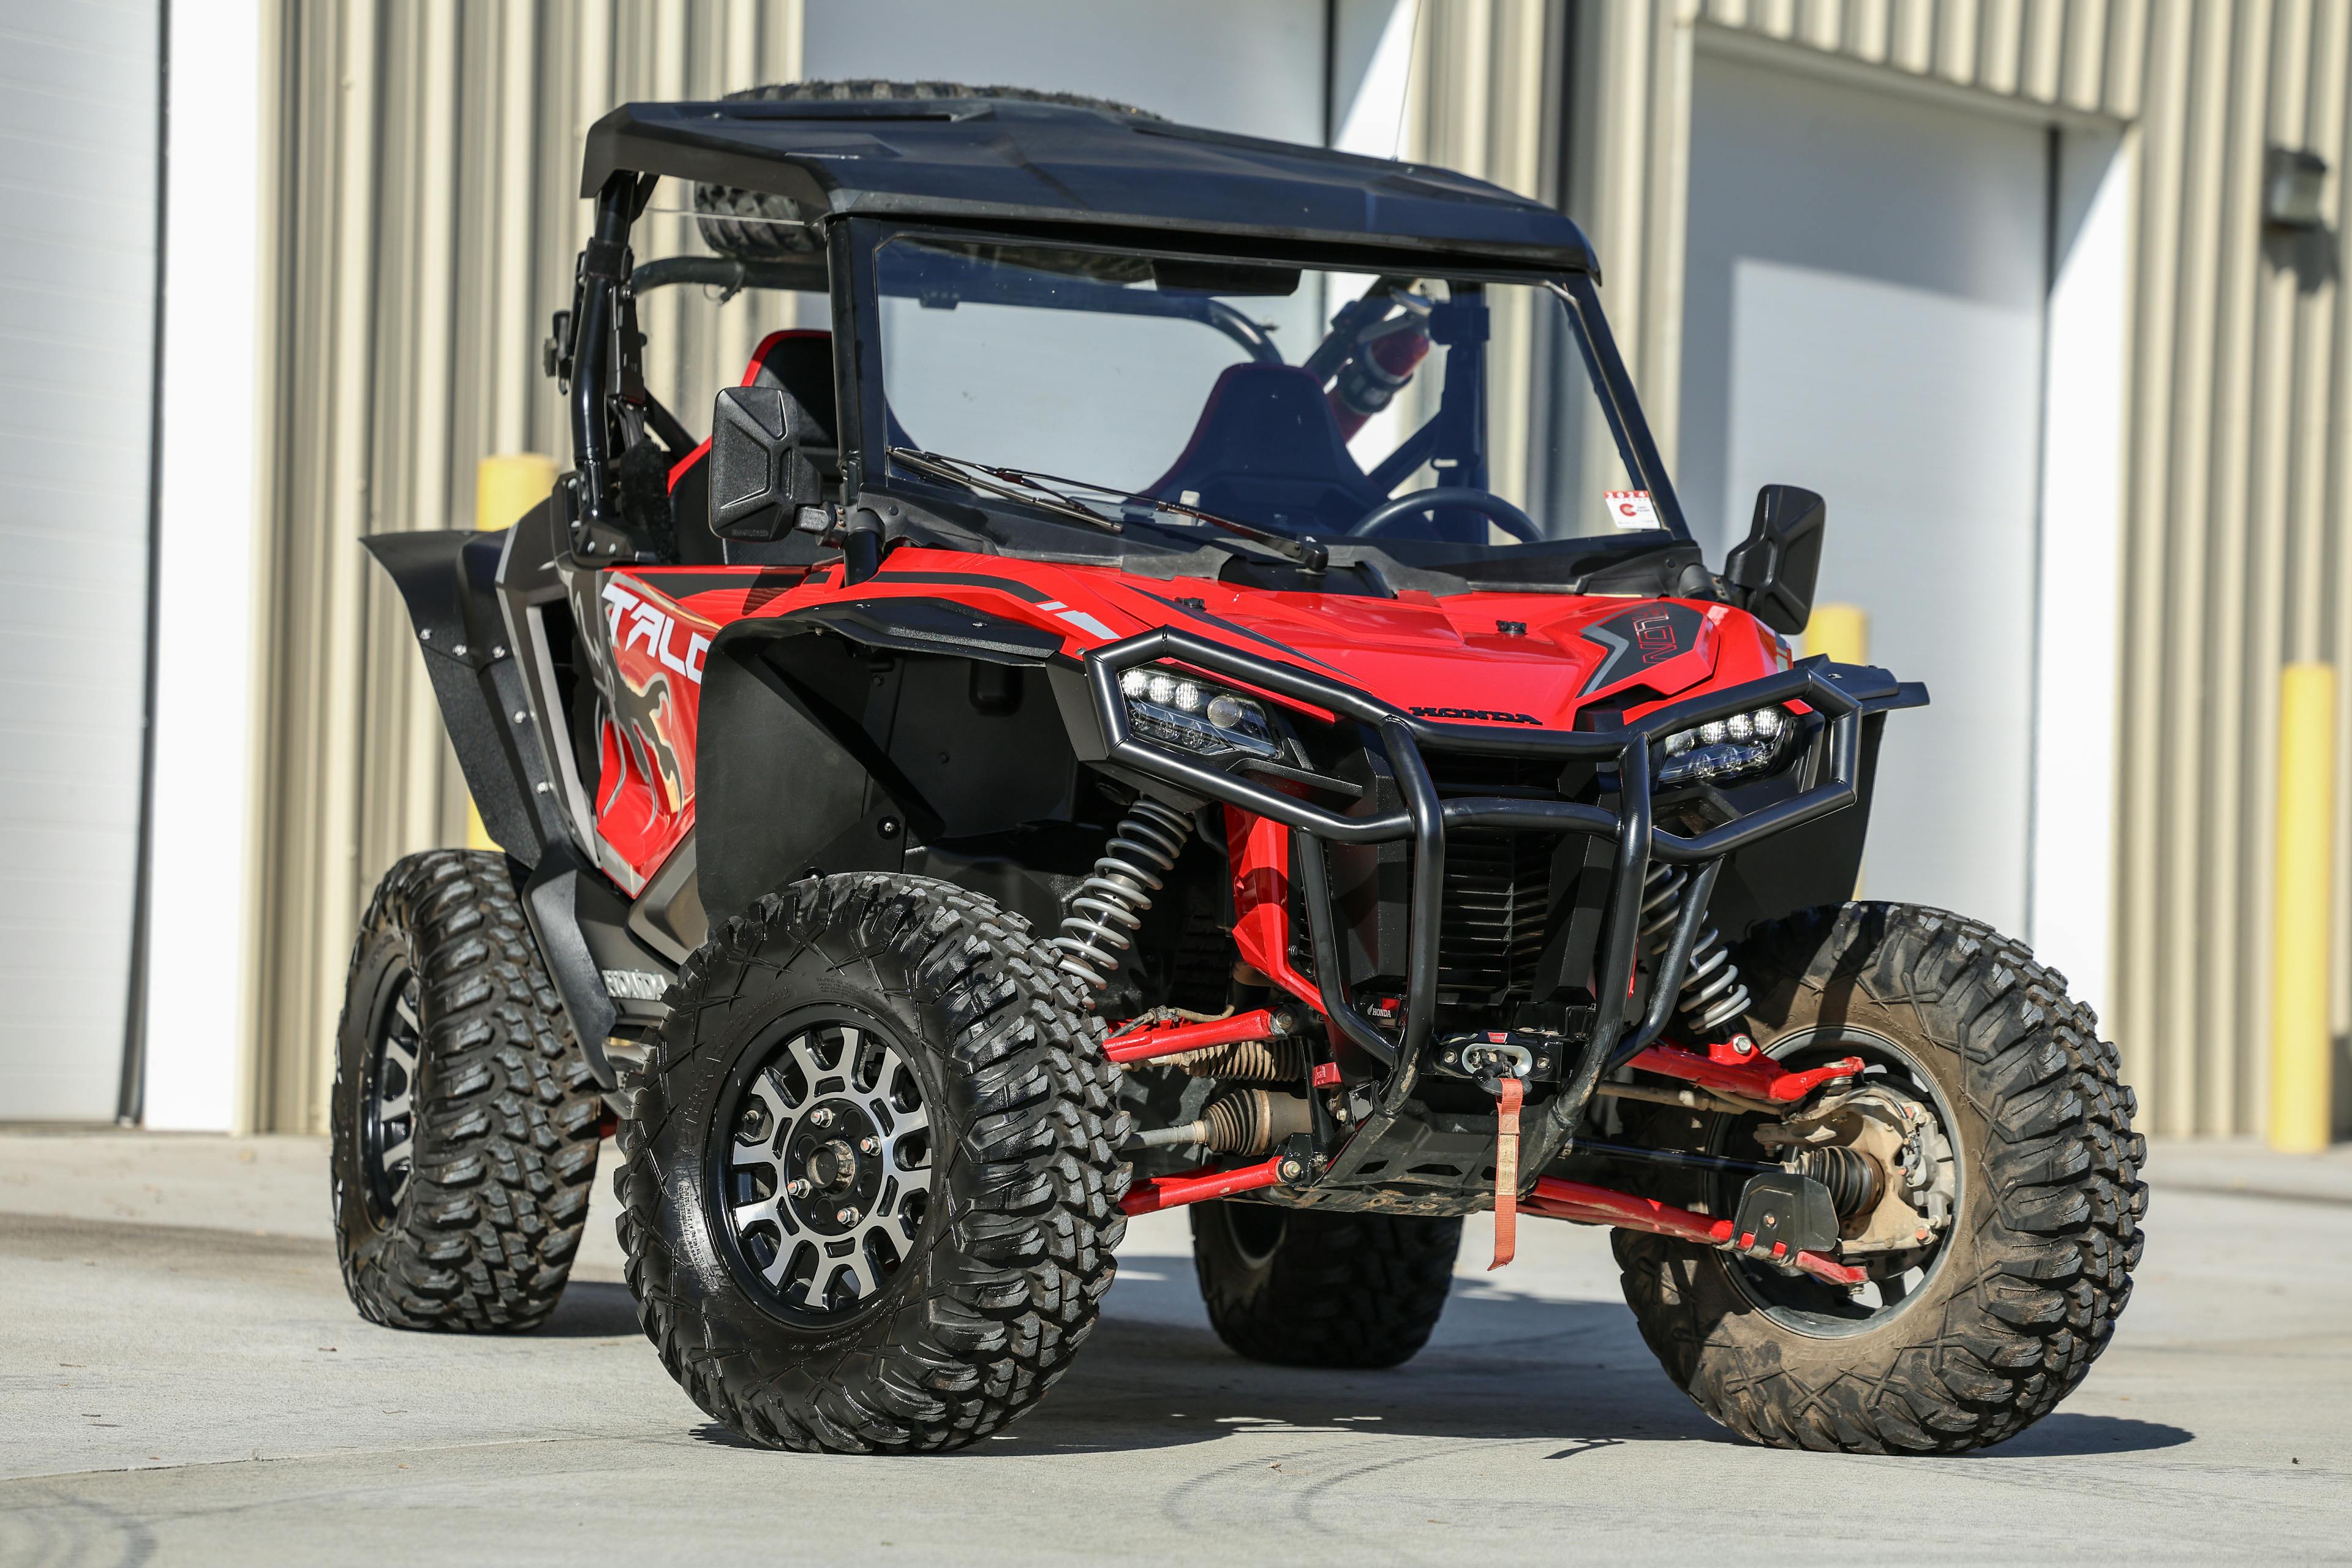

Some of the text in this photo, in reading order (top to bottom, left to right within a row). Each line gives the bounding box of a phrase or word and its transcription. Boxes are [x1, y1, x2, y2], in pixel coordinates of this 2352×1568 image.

[1408, 706, 1543, 726] HONDA
[601, 969, 667, 1001] HONDA
[1372, 1008, 1392, 1018] HONDA
